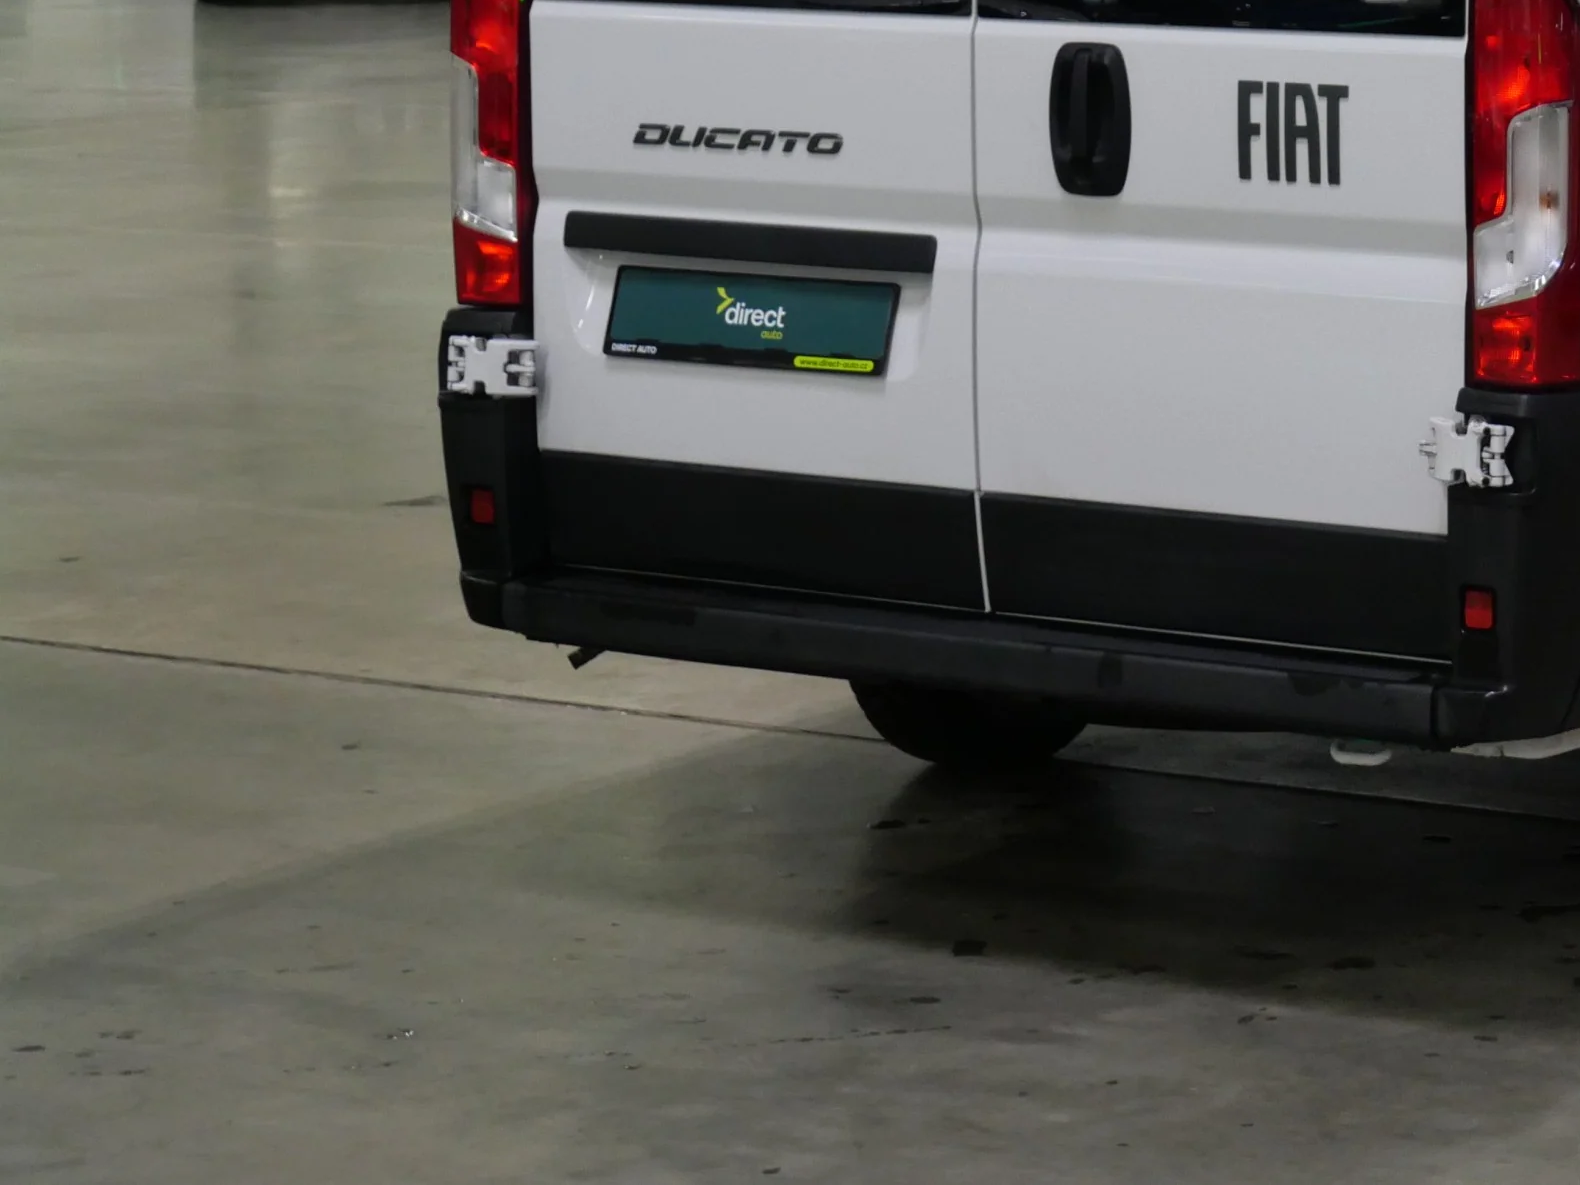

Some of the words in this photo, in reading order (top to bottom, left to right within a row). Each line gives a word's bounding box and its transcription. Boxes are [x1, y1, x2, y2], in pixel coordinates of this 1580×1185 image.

[633, 123, 844, 155] DUCATO
[1237, 79, 1349, 186] FIAT
[724, 301, 786, 328] direct
[611, 342, 637, 353] DIRECT
[636, 344, 658, 355] AUTO
